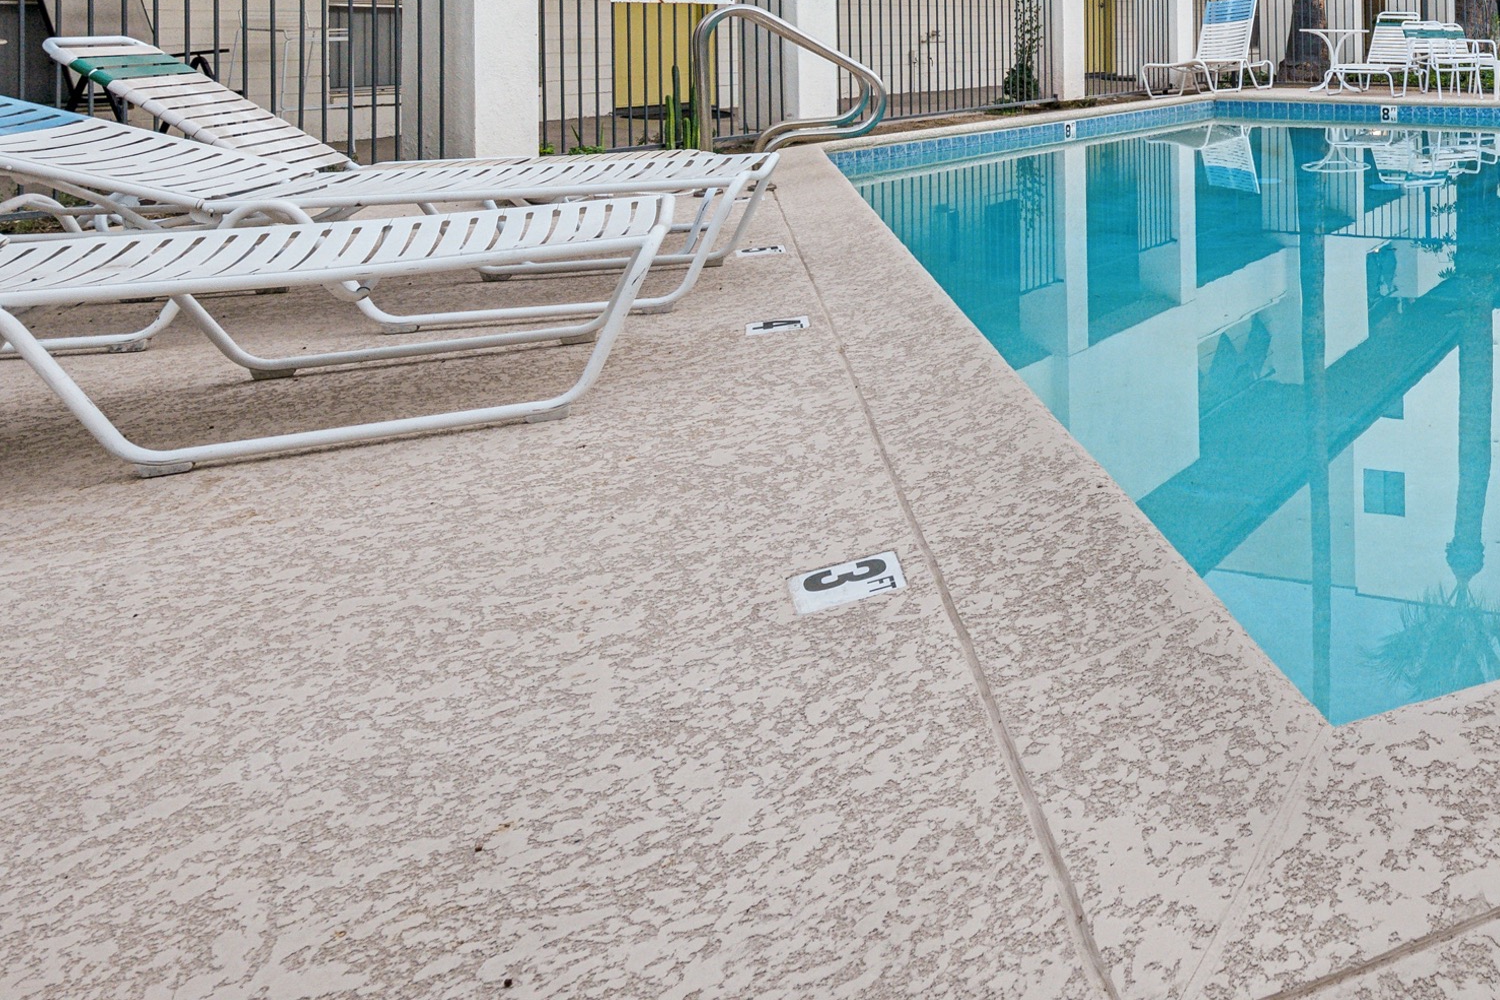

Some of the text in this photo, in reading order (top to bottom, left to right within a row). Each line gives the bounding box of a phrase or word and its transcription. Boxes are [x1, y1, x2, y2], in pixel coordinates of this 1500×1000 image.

[1381, 107, 1390, 121] 8
[803, 559, 897, 593] 3 FT
